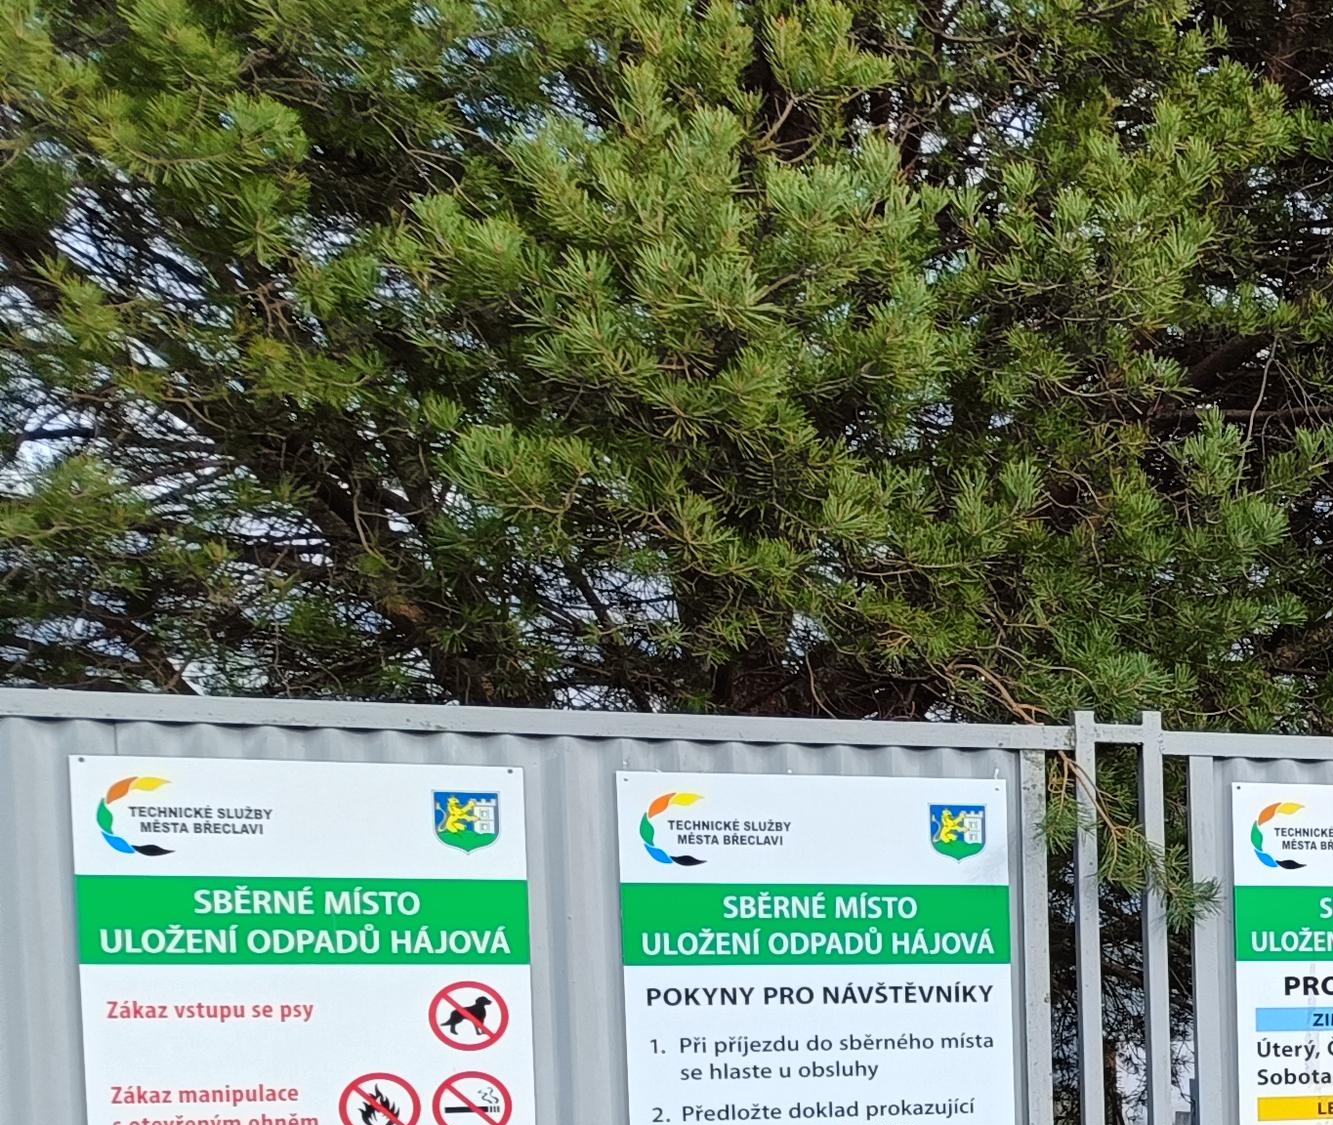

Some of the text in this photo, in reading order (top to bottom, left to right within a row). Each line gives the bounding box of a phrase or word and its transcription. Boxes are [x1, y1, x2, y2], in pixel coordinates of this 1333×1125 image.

[129, 805, 272, 820] TECHNICKÉ SLUŽBY
[140, 820, 263, 834] MĚSTA BŘECLAVI
[1274, 826, 1333, 838] TECHNICKÉ
[1282, 839, 1317, 850] MĚSTA
[194, 886, 420, 915] SBĚRNÉ MÍSTO
[724, 892, 917, 918] SBĚRNÉ MÍSTO
[100, 924, 510, 953] ULOŽENÍ ODPADŮ HÁJOVÁ
[642, 927, 994, 955] ULOŽENÍ ODPADŮ HÁJOVÁ
[647, 982, 992, 1006] POKYNY PRO NÁVŠTĚVNÍKY
[107, 1001, 313, 1023] Zákaz vstupu se psy
[650, 1033, 993, 1057] 1. Při příjezdu do sběrného místa
[1257, 1038, 1320, 1061] Úterý,
[681, 1061, 878, 1080] se hlaste u obsluhy
[1258, 1068, 1331, 1085] Sobota
[111, 1084, 298, 1107] Zákaz manipulace
[653, 1098, 974, 1122] 2. Předložte doklad prokazující
